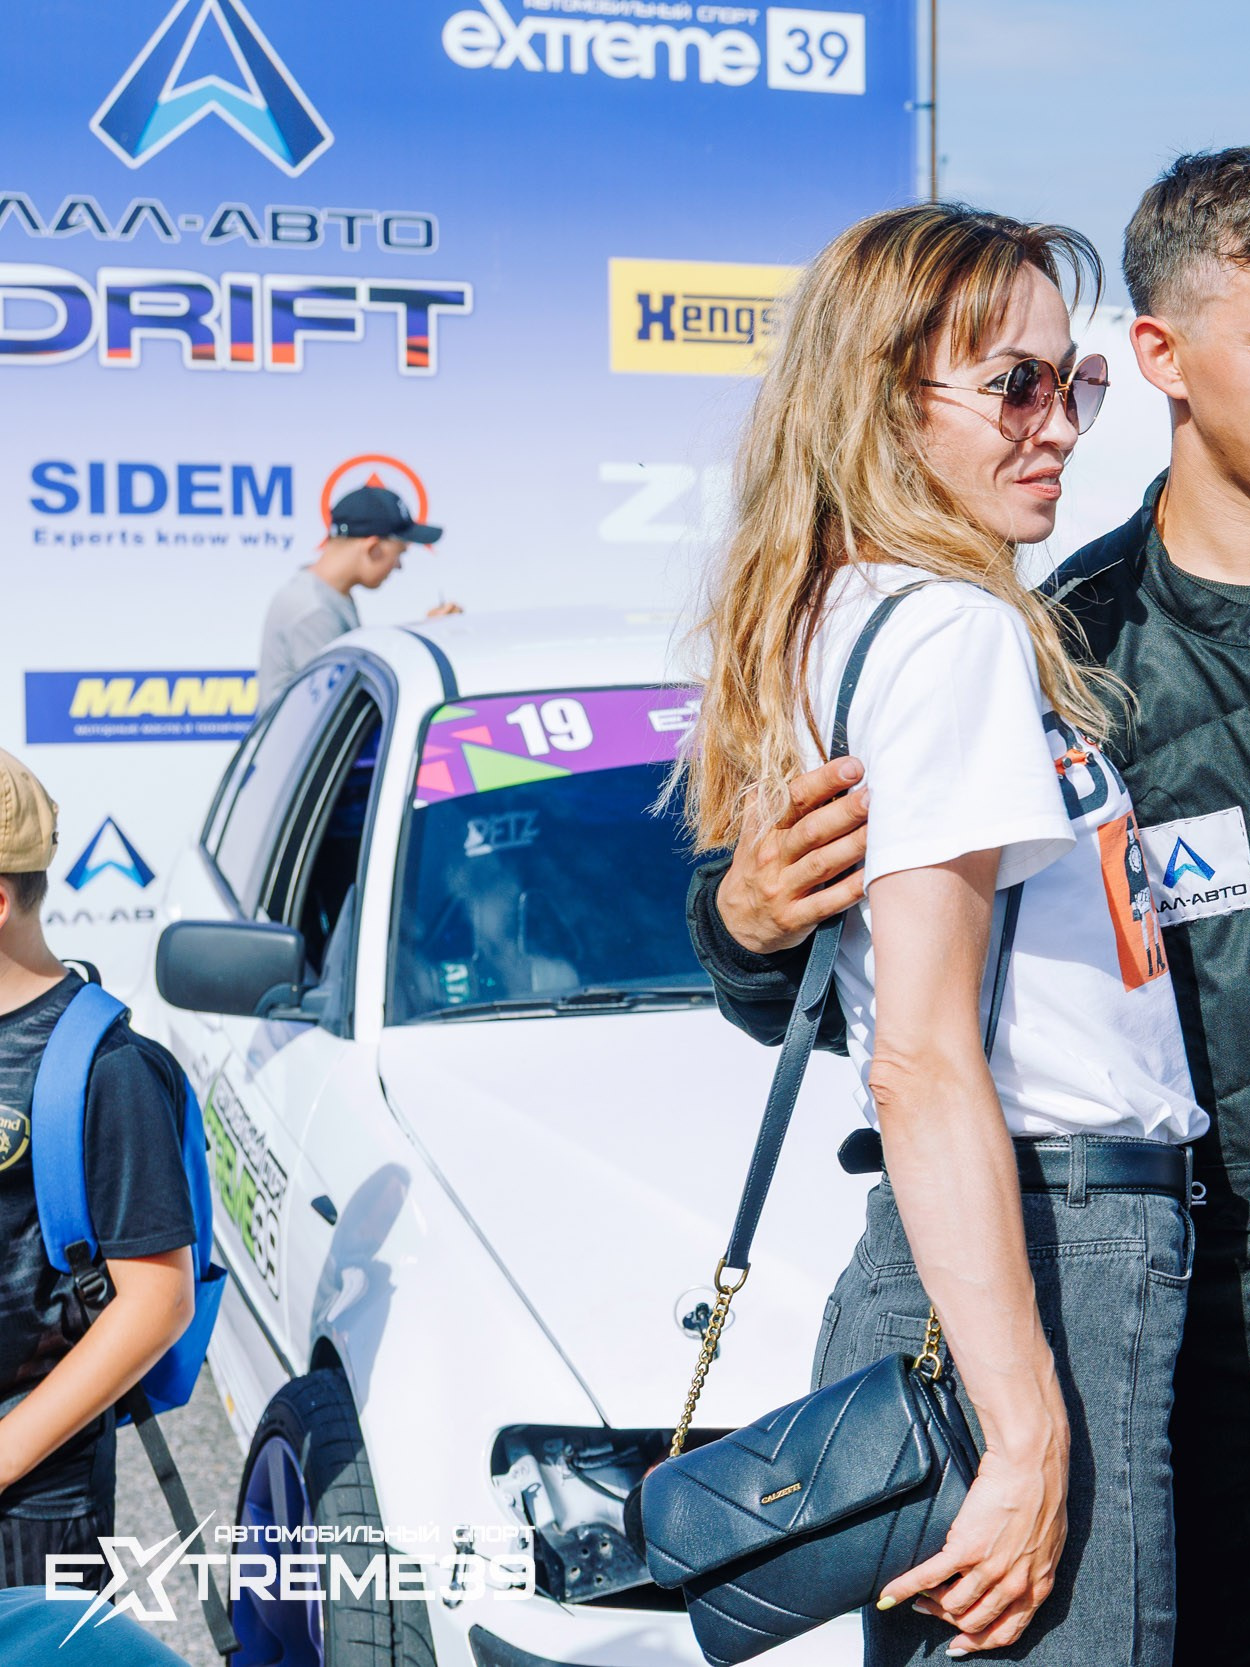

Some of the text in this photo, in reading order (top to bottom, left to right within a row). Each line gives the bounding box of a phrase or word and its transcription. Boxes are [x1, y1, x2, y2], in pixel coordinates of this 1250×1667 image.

[783, 27, 850, 78] 39
[0, 263, 473, 377] DRIFT
[30, 461, 293, 516] SIDEM
[33, 528, 294, 550] Experts know why
[505, 697, 594, 757] 19
[1155, 883, 1248, 913] АЛ-АВТО
